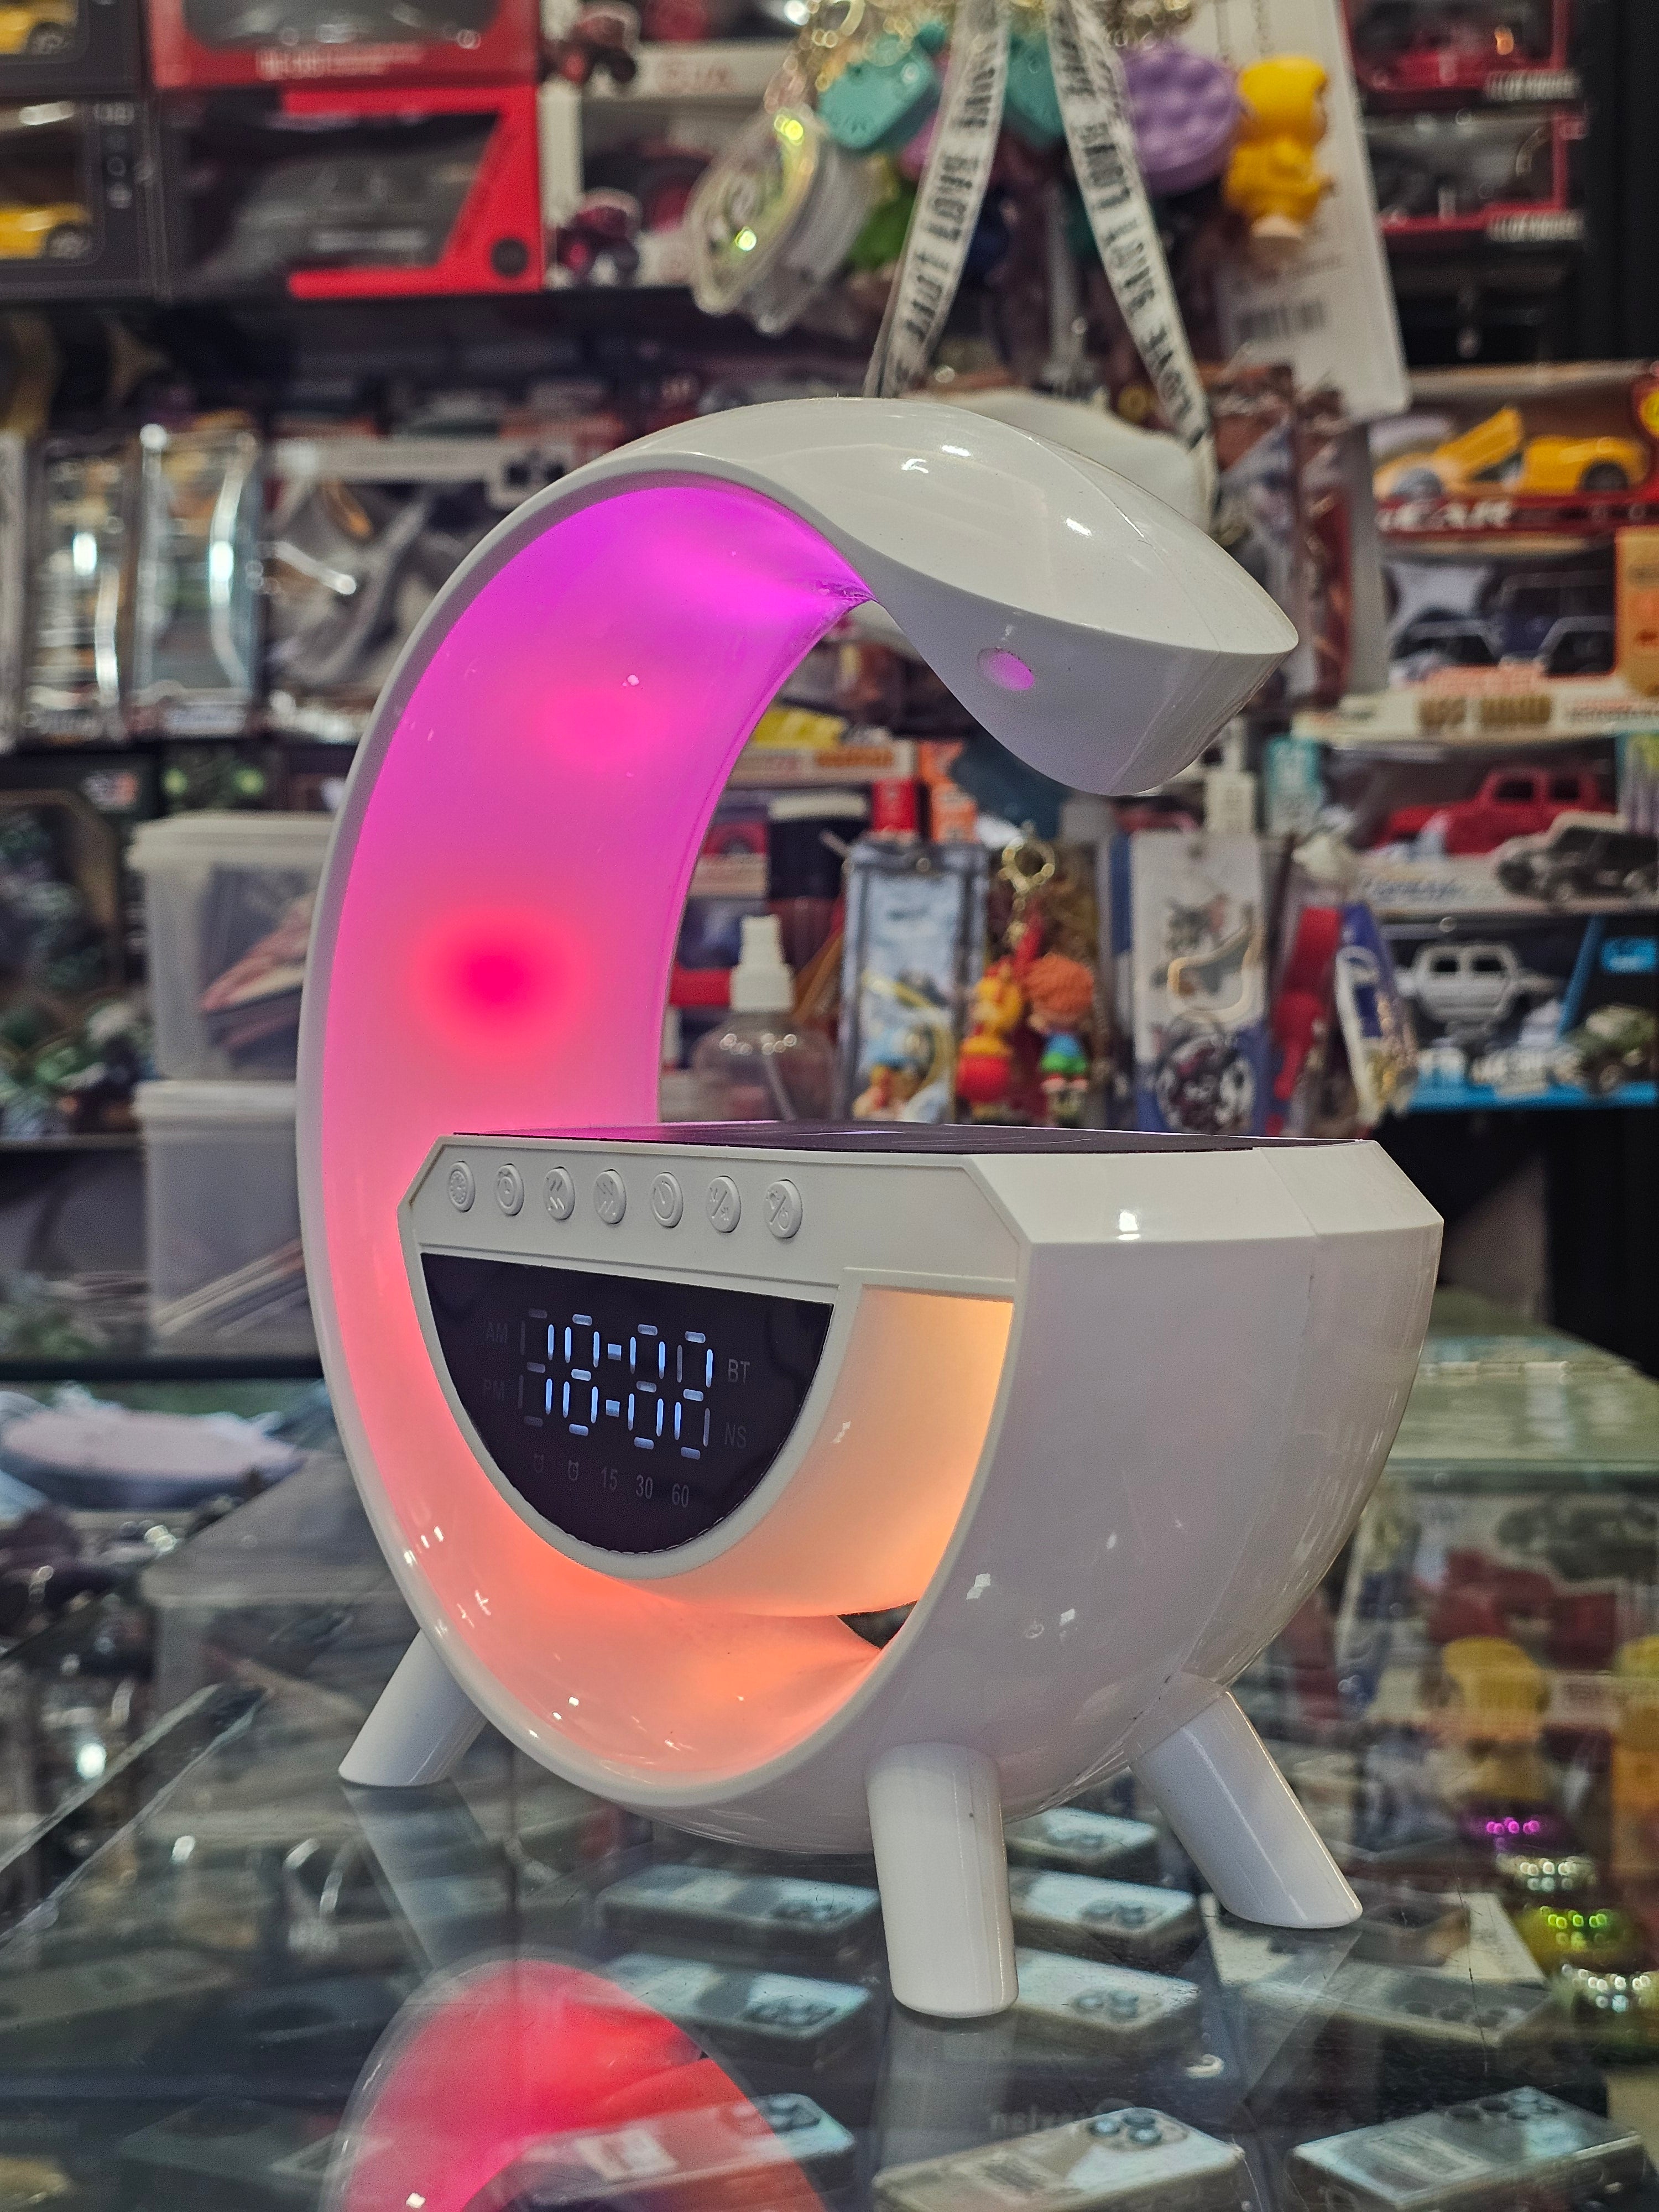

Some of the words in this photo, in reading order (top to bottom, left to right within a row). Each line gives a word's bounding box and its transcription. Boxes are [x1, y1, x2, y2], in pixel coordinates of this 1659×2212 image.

[727, 1358, 750, 1384] BT
[724, 1422, 747, 1449] NS
[601, 1467, 618, 1491] 15
[636, 1474, 653, 1500] 30
[672, 1483, 690, 1509] 60
